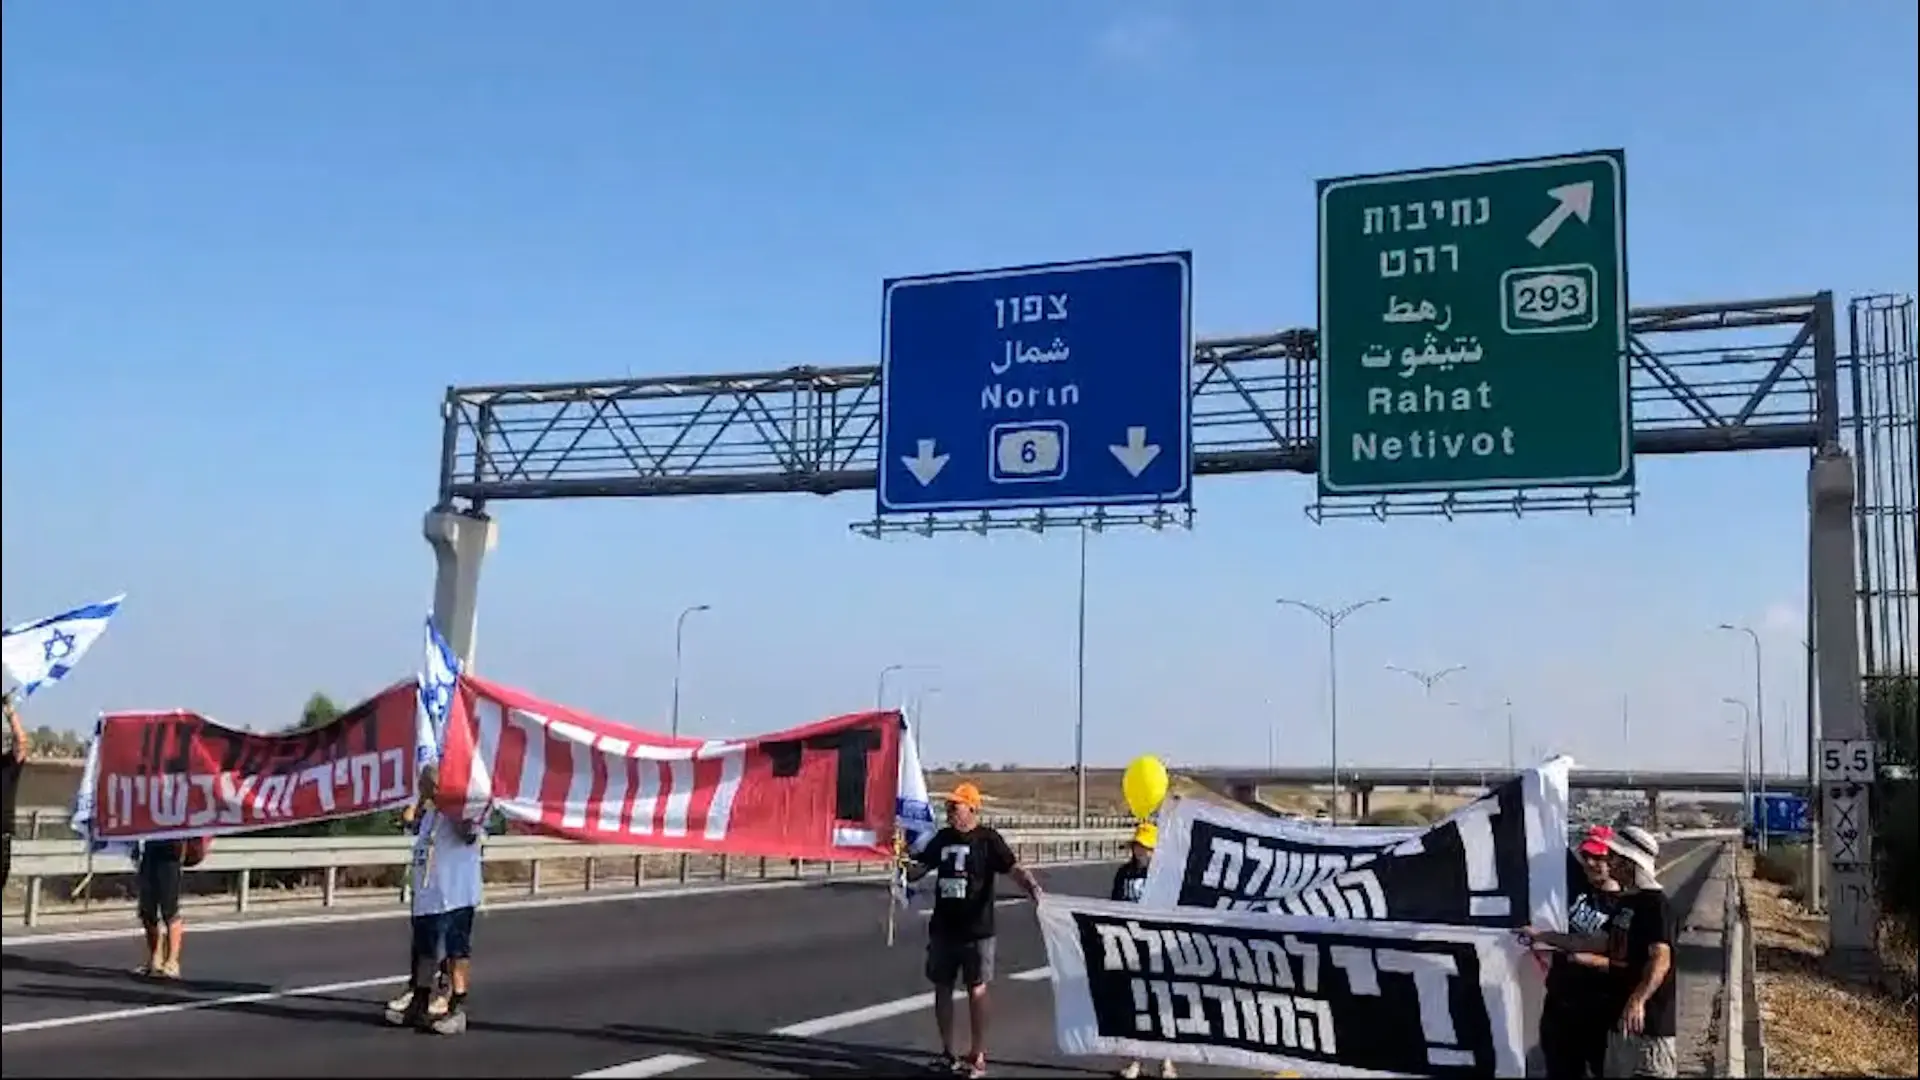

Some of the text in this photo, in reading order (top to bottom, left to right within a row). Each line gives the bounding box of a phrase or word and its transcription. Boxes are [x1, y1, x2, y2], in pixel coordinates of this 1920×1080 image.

[1362, 196, 1491, 235] נתיבות
[1379, 243, 1459, 279] רהט
[994, 292, 1069, 329] צפון
[1382, 294, 1452, 331] رهط
[1517, 283, 1581, 314] 293
[990, 336, 1070, 375] شمال
[1367, 380, 1493, 415] Rahat
[1020, 440, 1037, 464] 6
[1351, 425, 1516, 462] Netivot
[1825, 749, 1869, 772] 5.5
